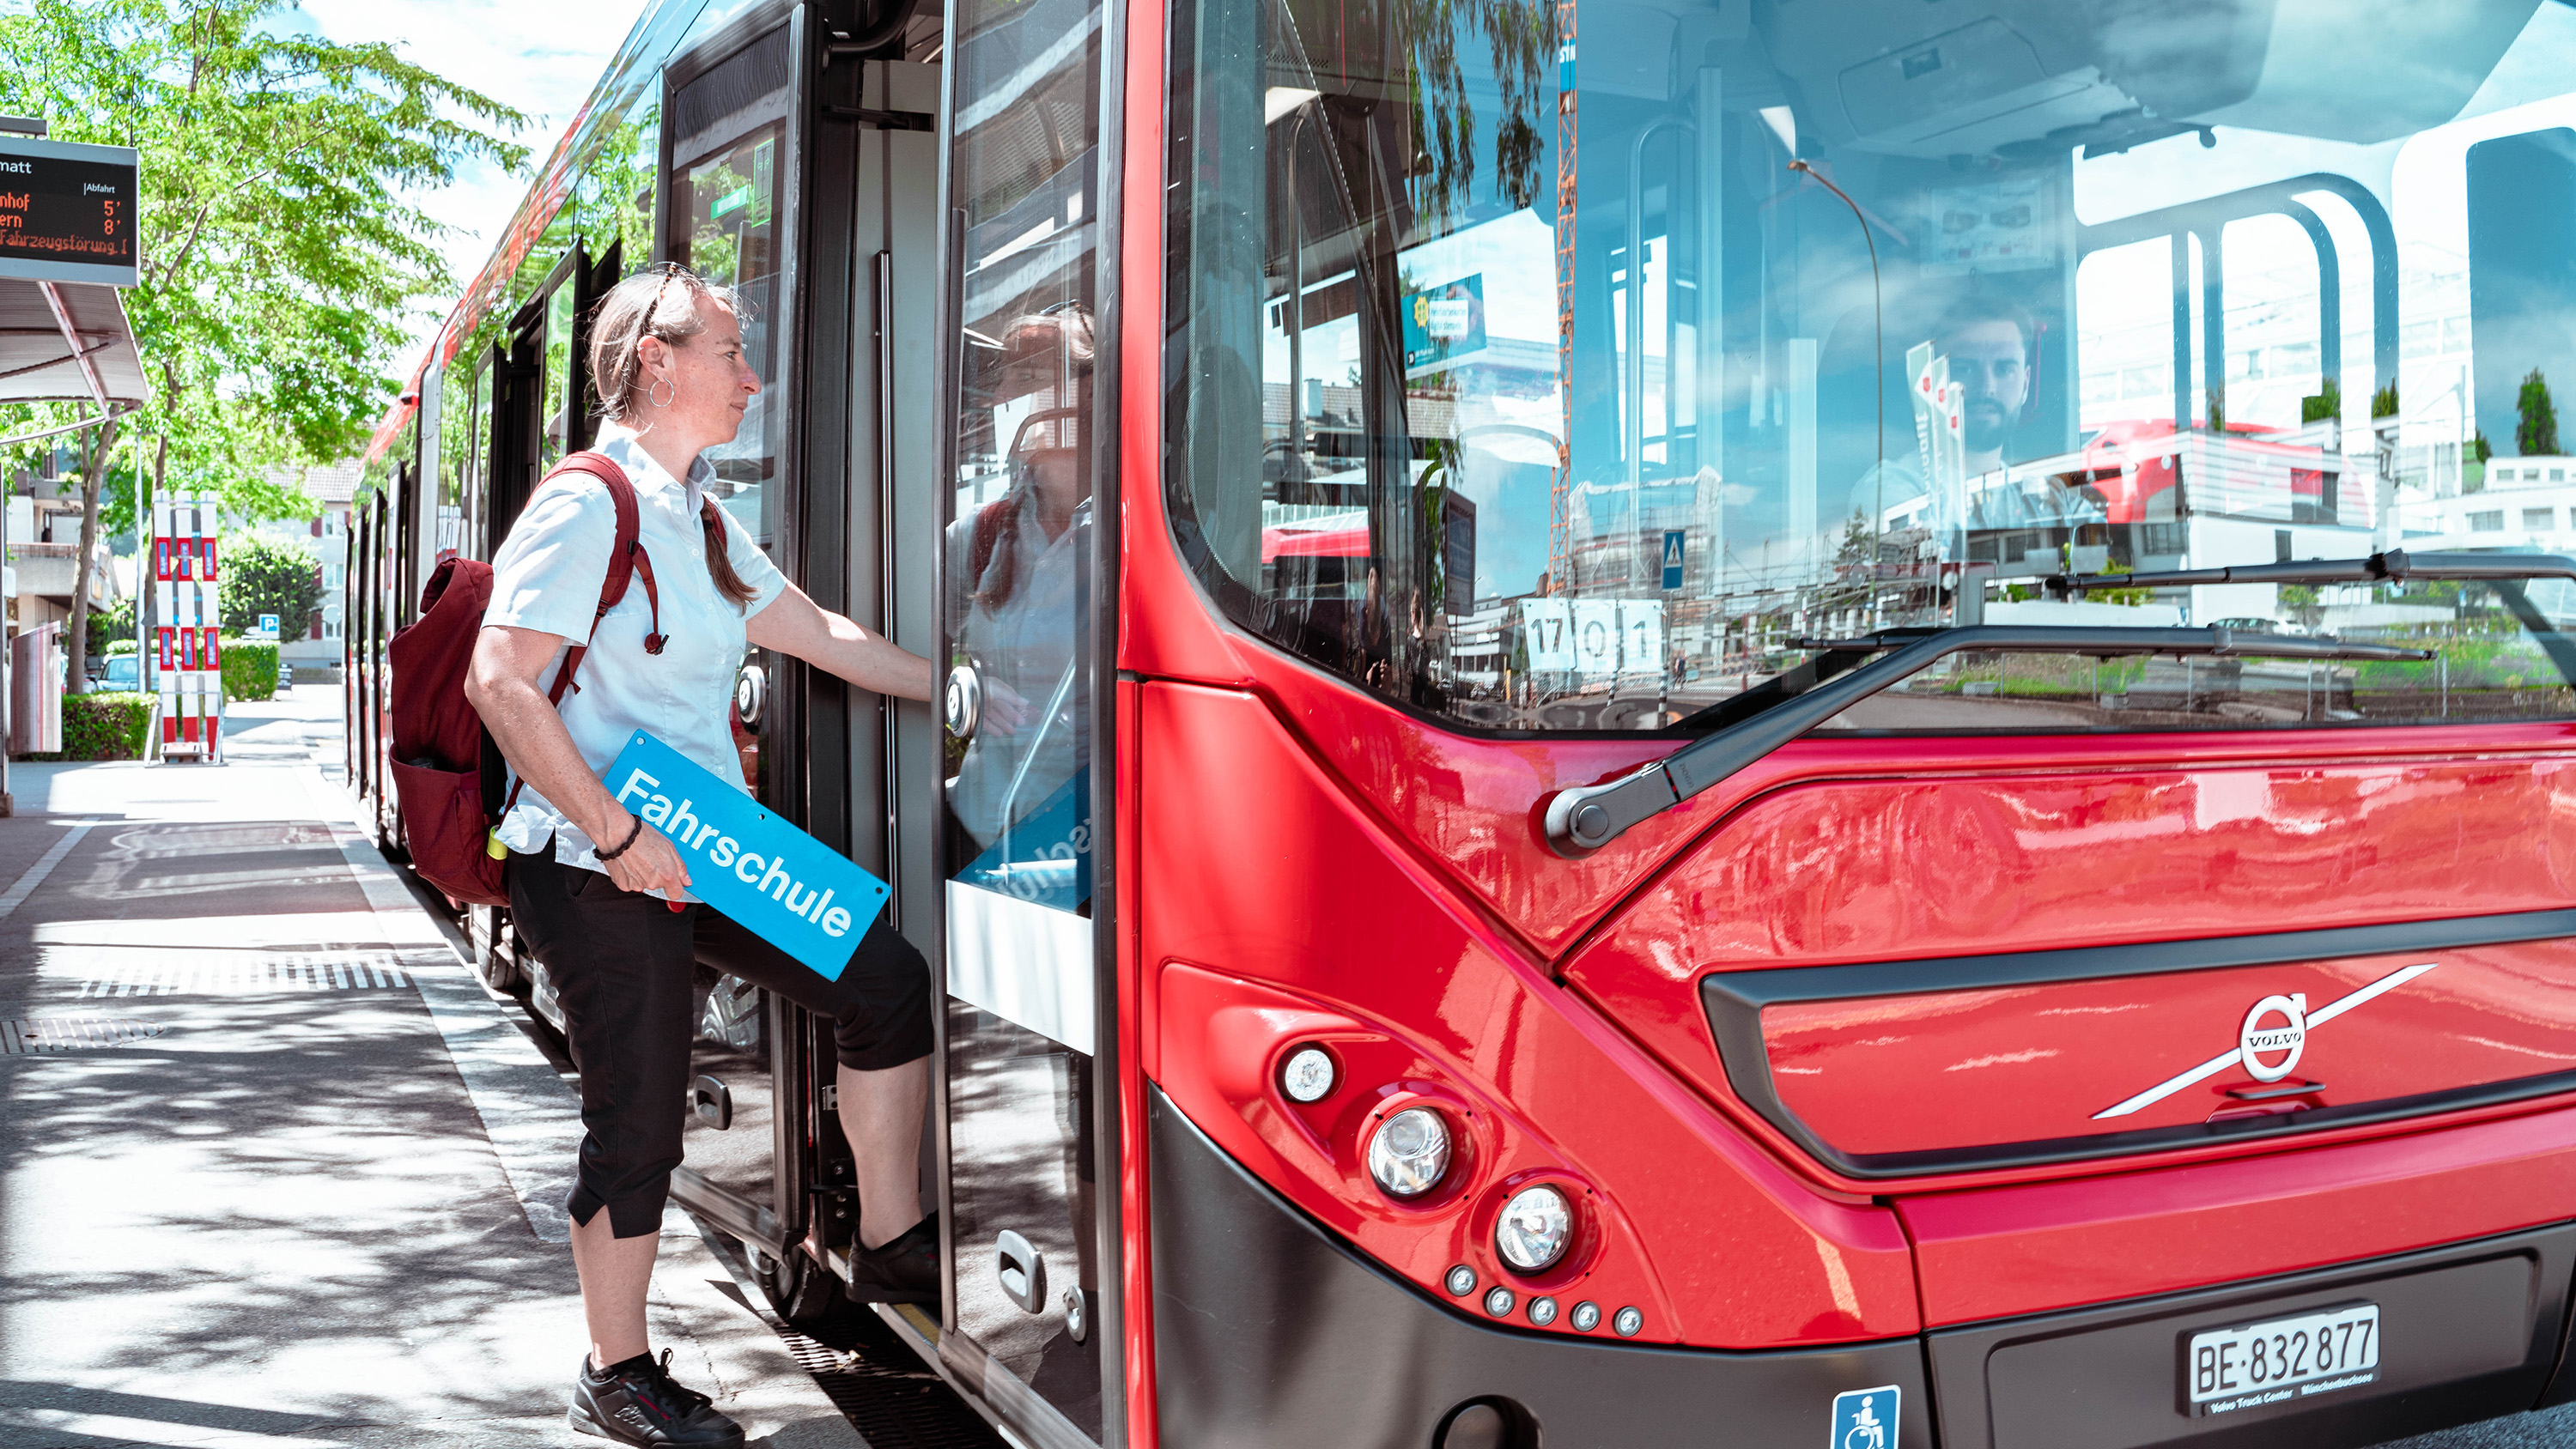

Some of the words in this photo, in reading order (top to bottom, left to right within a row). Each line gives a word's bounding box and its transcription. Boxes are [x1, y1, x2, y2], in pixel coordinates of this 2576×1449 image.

[86, 183, 115, 194] Abfahrt
[264, 618, 275, 631] P
[1530, 618, 1563, 653] 17
[616, 767, 852, 937] Fahrschule
[2248, 1032, 2301, 1046] VOLVO
[2210, 1400, 2236, 1414] Volvo
[2263, 1389, 2293, 1404] Center
